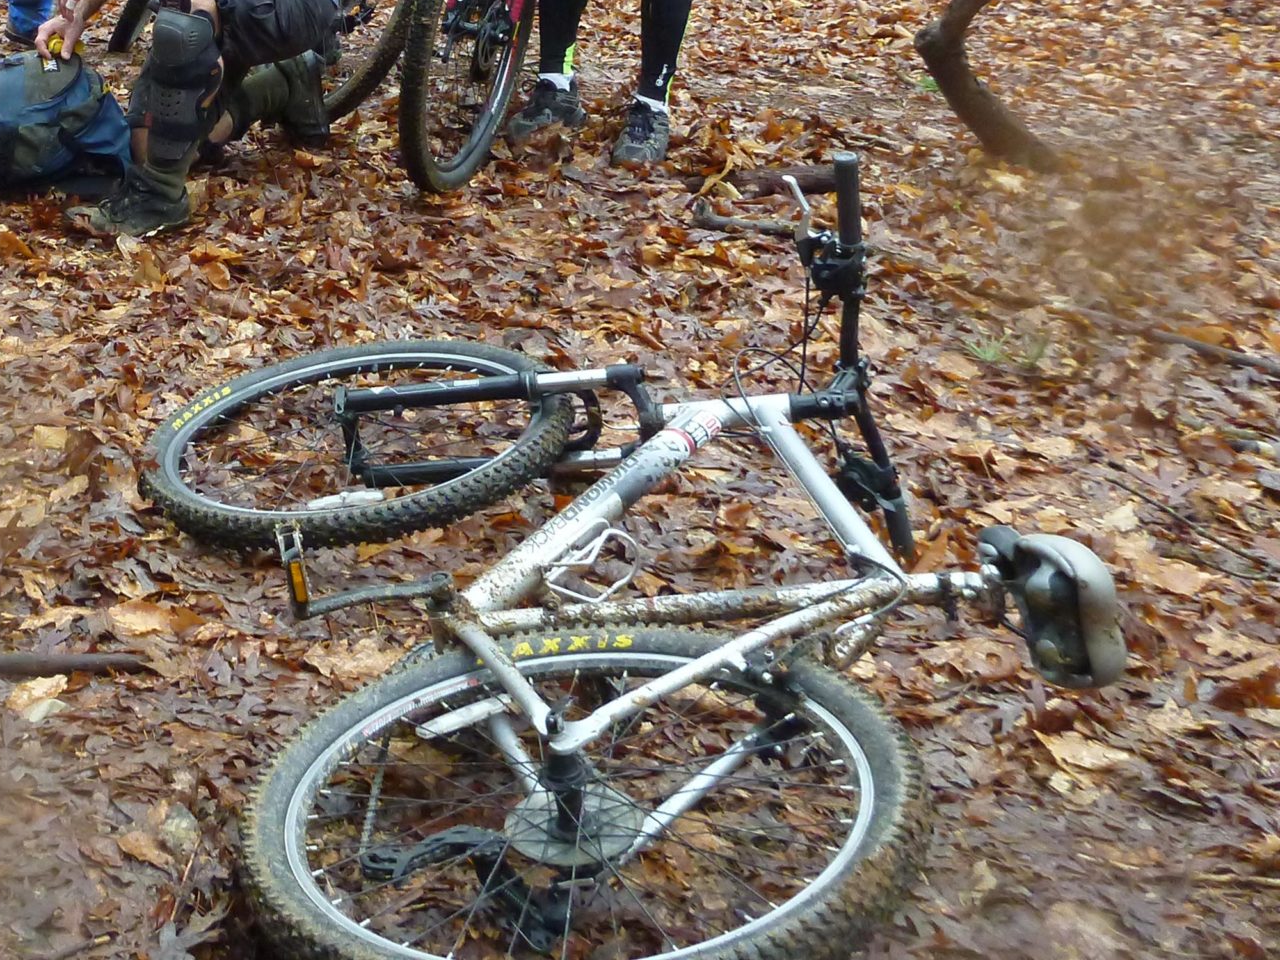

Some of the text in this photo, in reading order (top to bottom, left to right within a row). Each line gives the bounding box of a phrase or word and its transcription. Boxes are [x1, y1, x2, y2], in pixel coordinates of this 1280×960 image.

[171, 386, 233, 431] MAXXIS
[529, 457, 640, 552] DIAMONDBACK
[476, 634, 635, 665] AXXIS
